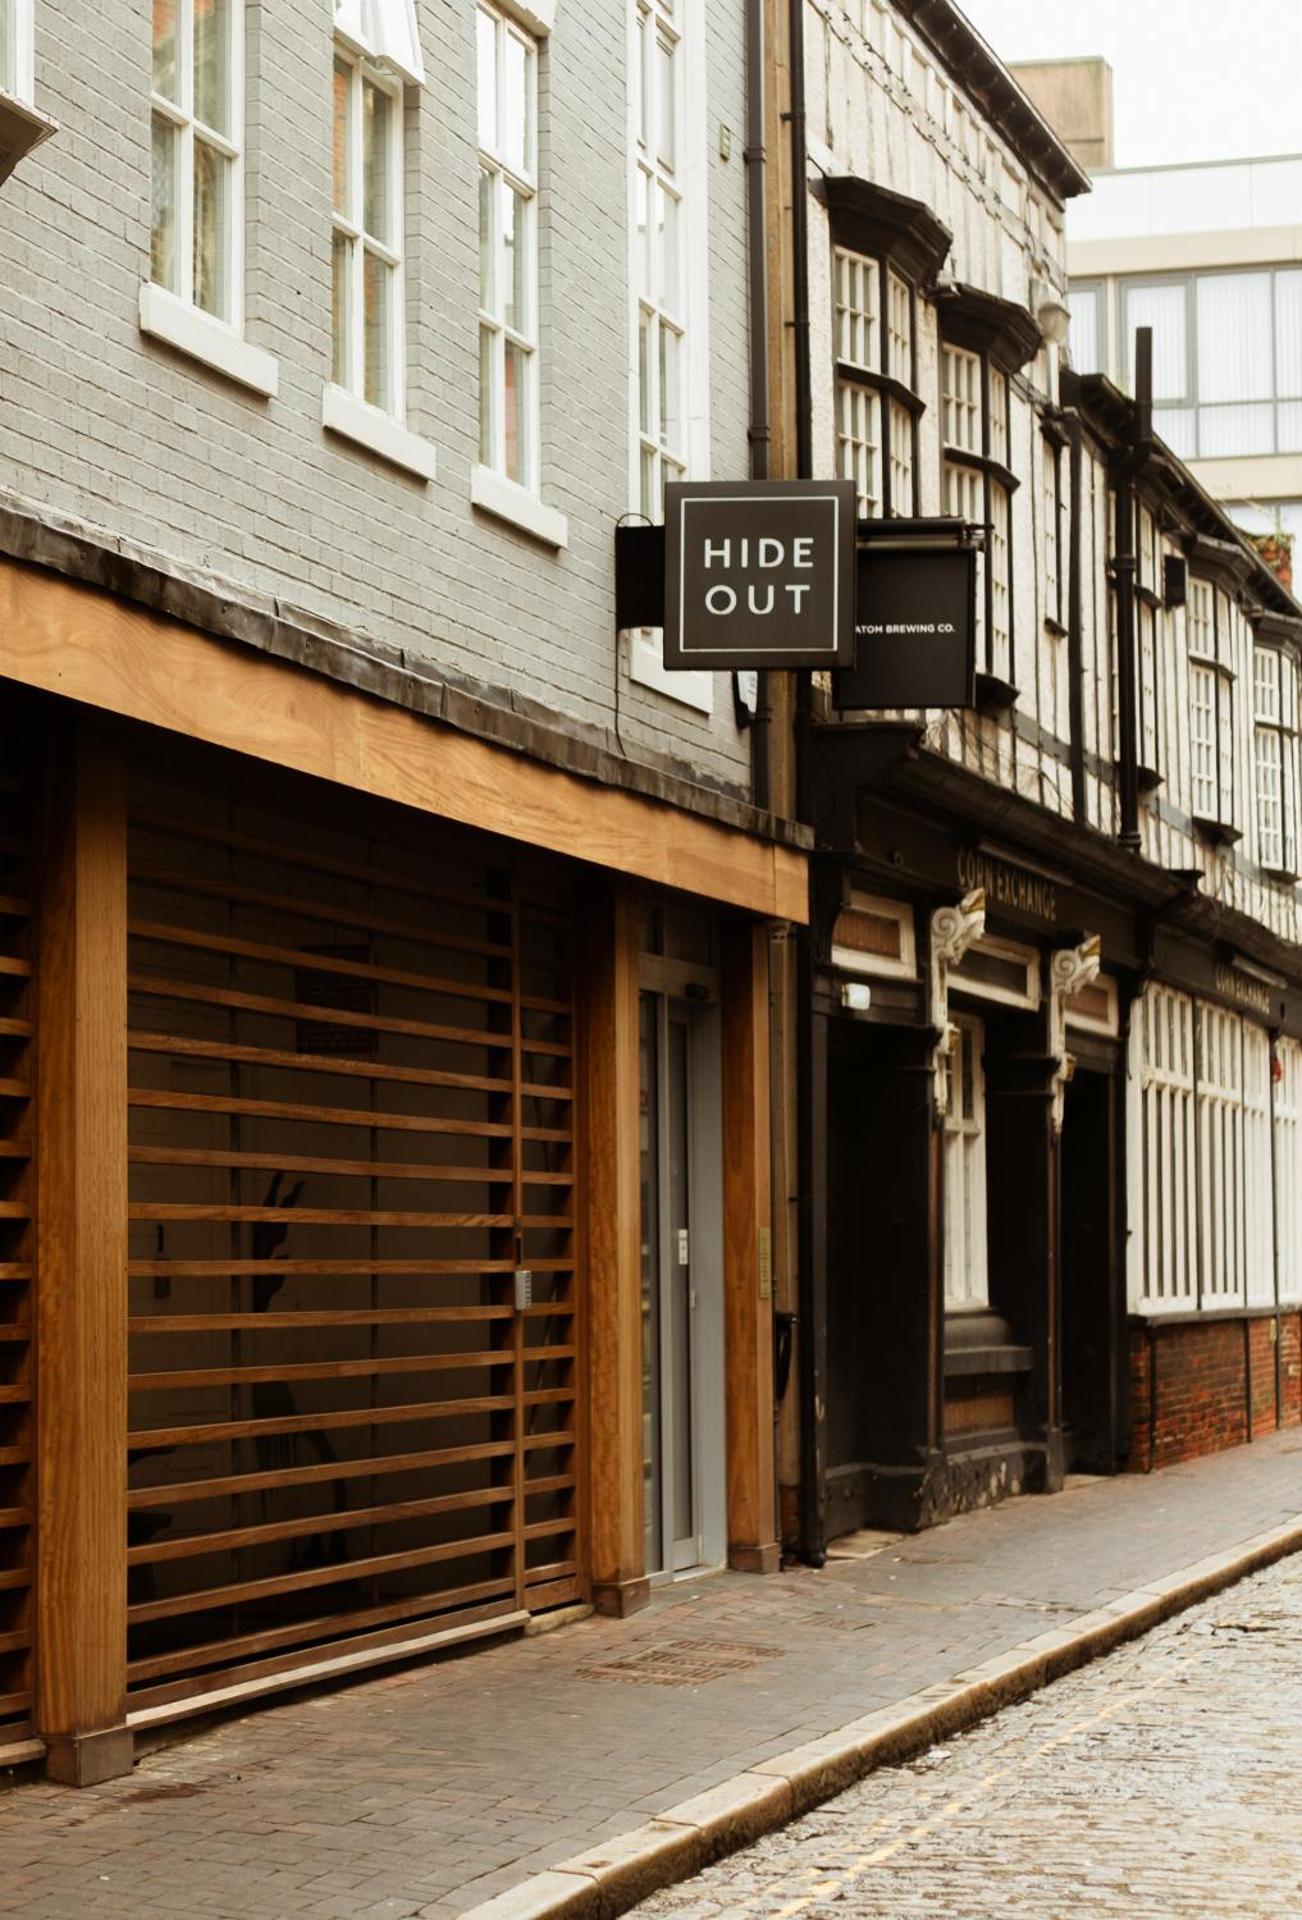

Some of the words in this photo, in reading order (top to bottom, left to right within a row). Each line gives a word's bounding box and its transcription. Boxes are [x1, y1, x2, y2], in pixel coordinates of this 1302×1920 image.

[704, 537, 814, 569] HIDE
[704, 584, 811, 615] OUT
[855, 624, 884, 634] ATOM
[886, 623, 935, 634] BREWING
[937, 622, 956, 633] CO.
[997, 865, 1056, 922] EXCHANGE
